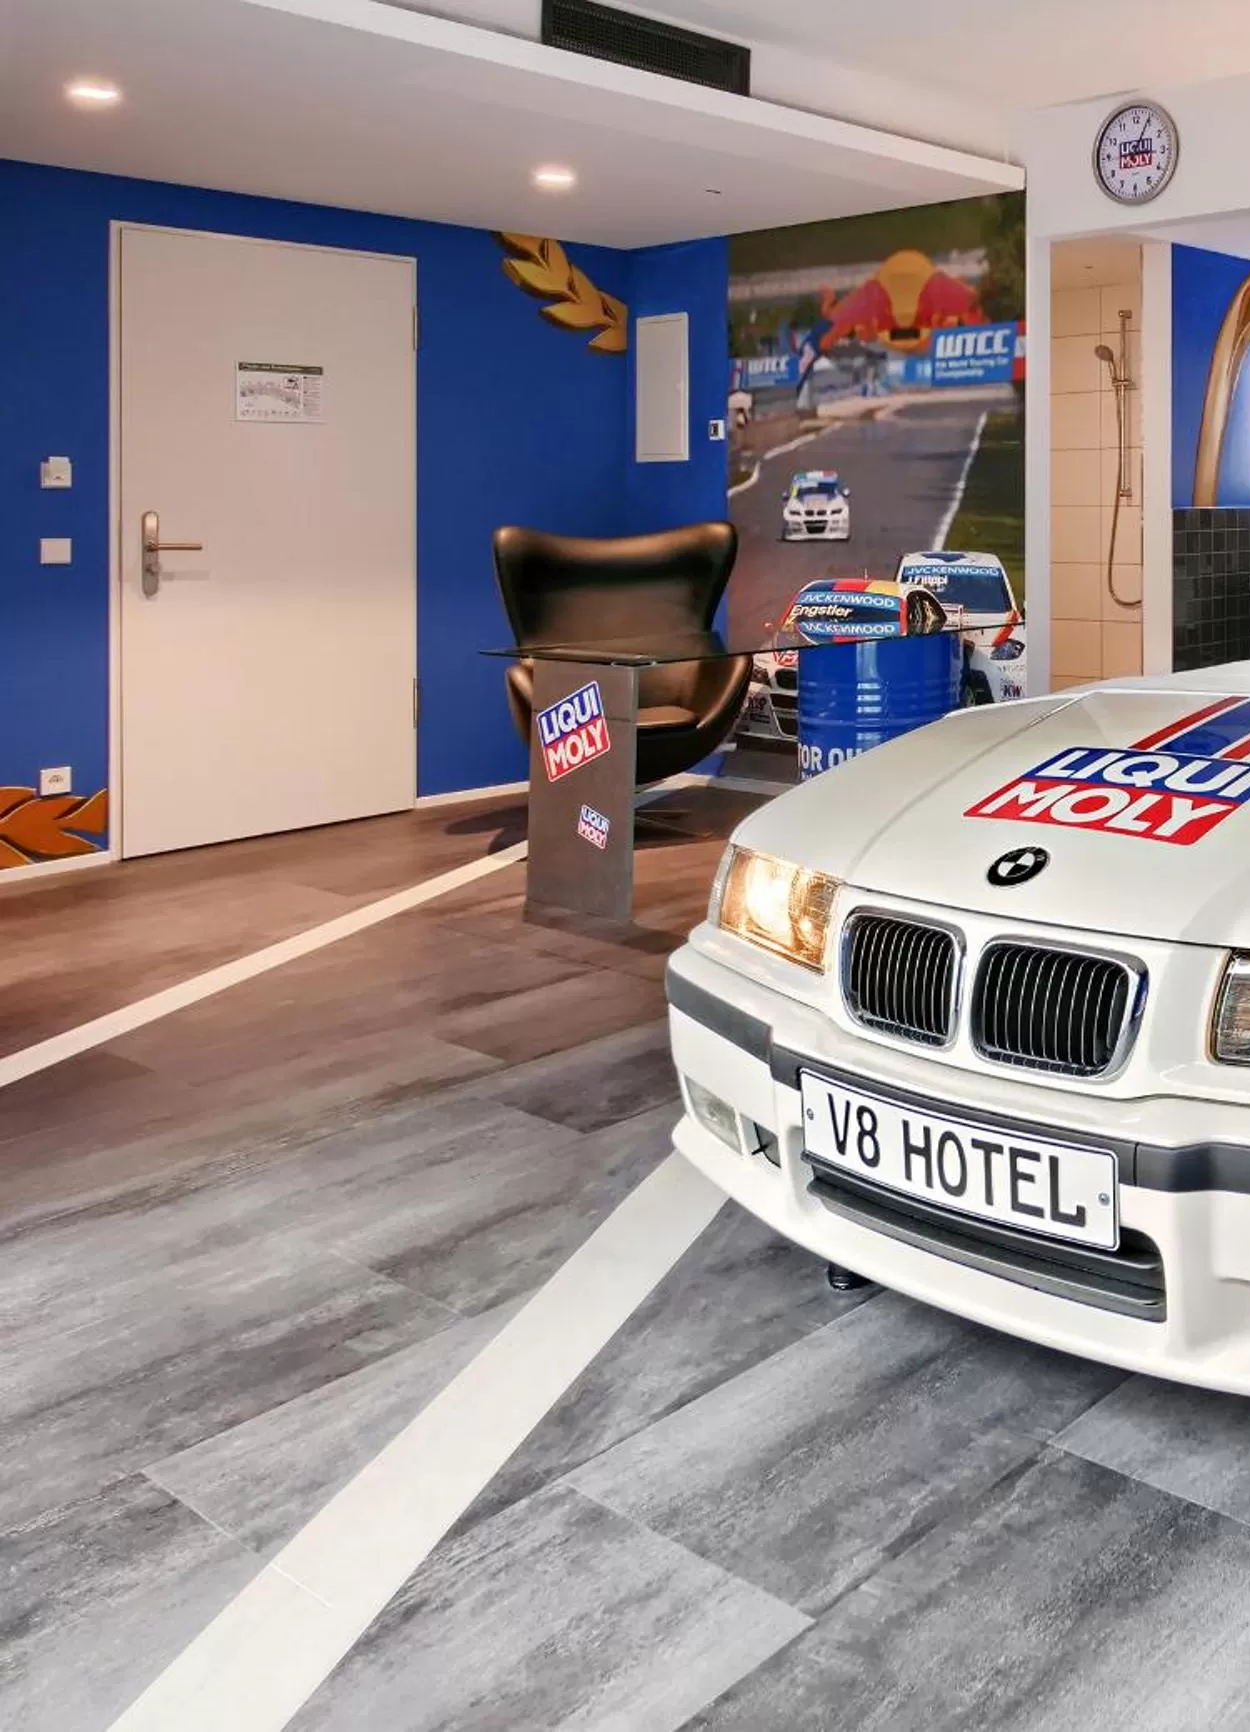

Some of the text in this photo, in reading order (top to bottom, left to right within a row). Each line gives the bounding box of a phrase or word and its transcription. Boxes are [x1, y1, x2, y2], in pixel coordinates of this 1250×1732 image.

[1121, 153, 1152, 167] MOLY
[936, 329, 1011, 358] WTCC
[791, 604, 853, 617] Engstler
[540, 687, 600, 744] LIQUI
[546, 719, 604, 776] MOLY
[582, 806, 609, 832] LIQUI
[977, 781, 1235, 837] MOLY
[580, 821, 606, 847] MOLY
[828, 1092, 1087, 1228] V8 HOTEL
